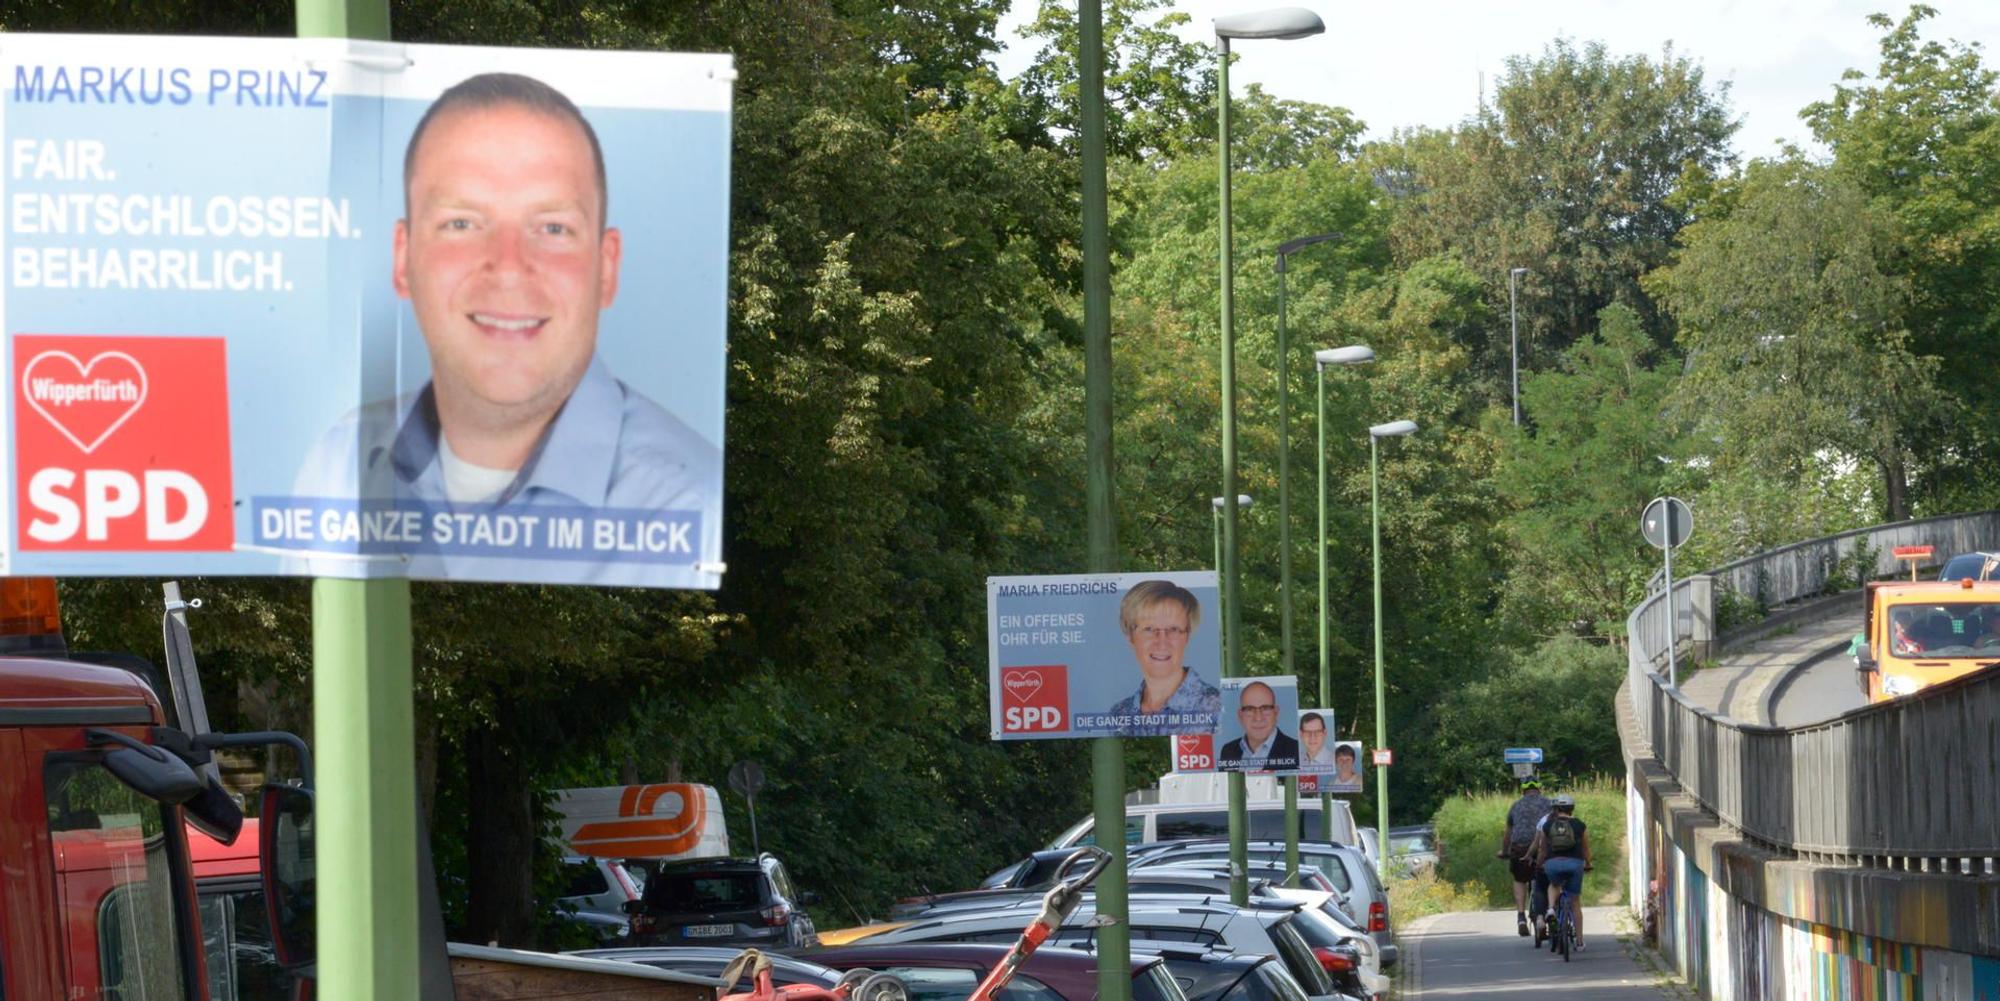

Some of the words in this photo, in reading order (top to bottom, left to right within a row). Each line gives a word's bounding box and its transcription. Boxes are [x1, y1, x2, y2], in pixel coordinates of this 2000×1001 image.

[14, 65, 192, 105] MARKUS
[208, 69, 329, 107] PRINZ
[12, 139, 116, 181] FAIR.
[12, 193, 362, 239] ENTSCHLOSSEN.
[12, 247, 294, 291] BEHARRLICH.
[32, 376, 139, 406] Wipperfürth
[28, 467, 209, 543] SPD
[261, 507, 313, 541] DIE
[320, 509, 422, 545] GANZE
[432, 512, 538, 549] STADT
[547, 516, 584, 549] IM
[594, 516, 693, 553] BLICK
[1000, 584, 1039, 597] MARIA
[1043, 582, 1117, 595] FRIEDRICHS
[1000, 615, 1021, 628] EIN
[1025, 613, 1085, 627] OFFENES
[1000, 632, 1028, 645] OHR
[1032, 629, 1058, 645] FÜR
[1062, 629, 1086, 644] SIE.
[1006, 706, 1061, 730] SPD
[1077, 715, 1093, 727] DIE
[1096, 715, 1131, 727] GANZE
[1134, 714, 1165, 726] STADT
[1168, 714, 1180, 725] IM
[1182, 713, 1213, 725] BLICK
[1180, 754, 1210, 768] SPD
[1299, 781, 1316, 790] SPD
